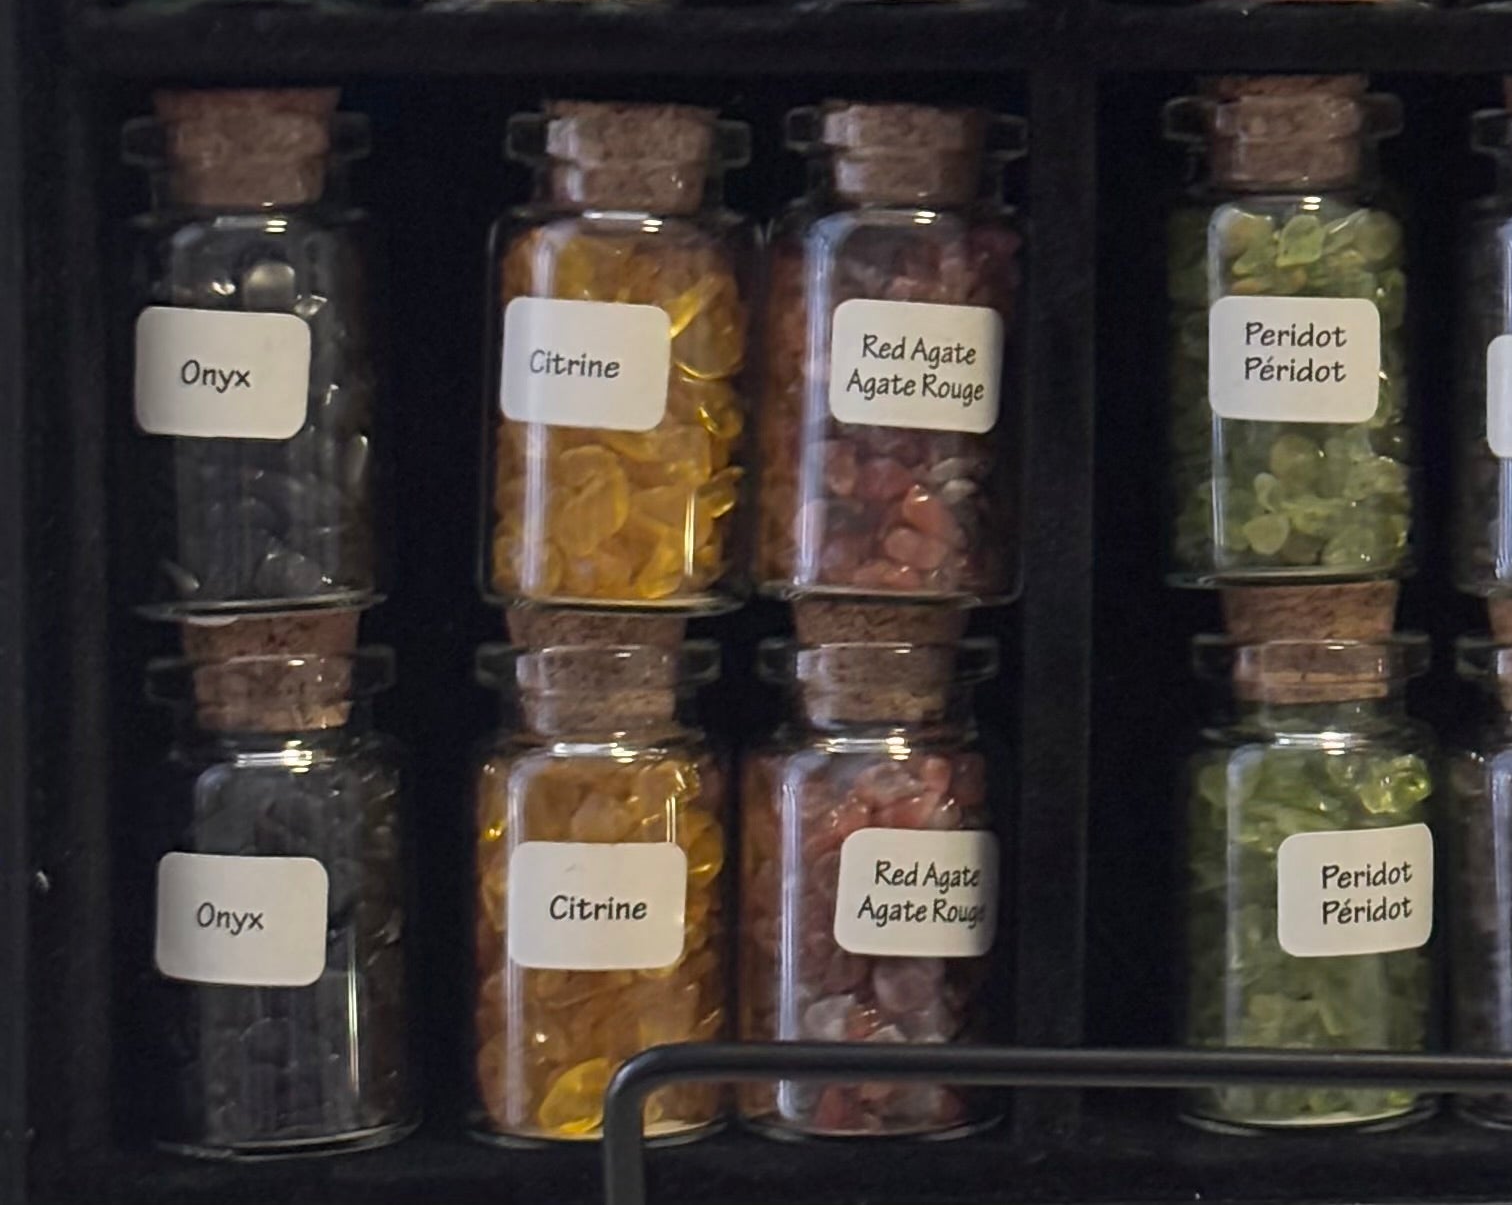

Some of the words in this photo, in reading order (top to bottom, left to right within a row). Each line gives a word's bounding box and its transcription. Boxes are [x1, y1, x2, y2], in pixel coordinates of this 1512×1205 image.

[1244, 322, 1347, 347] Peridot
[529, 349, 620, 380] Citrine
[861, 334, 906, 361] Red
[910, 338, 977, 369] Agate
[180, 359, 252, 391] Onyx
[1244, 356, 1346, 383] Péridot
[846, 368, 916, 400] Agate
[921, 374, 985, 406] Rouge
[874, 860, 919, 886] Red
[922, 864, 980, 891] Agate
[1321, 862, 1413, 890] Peridot
[196, 902, 264, 934] Onyx
[549, 895, 648, 921] Citrine
[857, 898, 928, 926] Agate
[1322, 898, 1413, 926] Péridot
